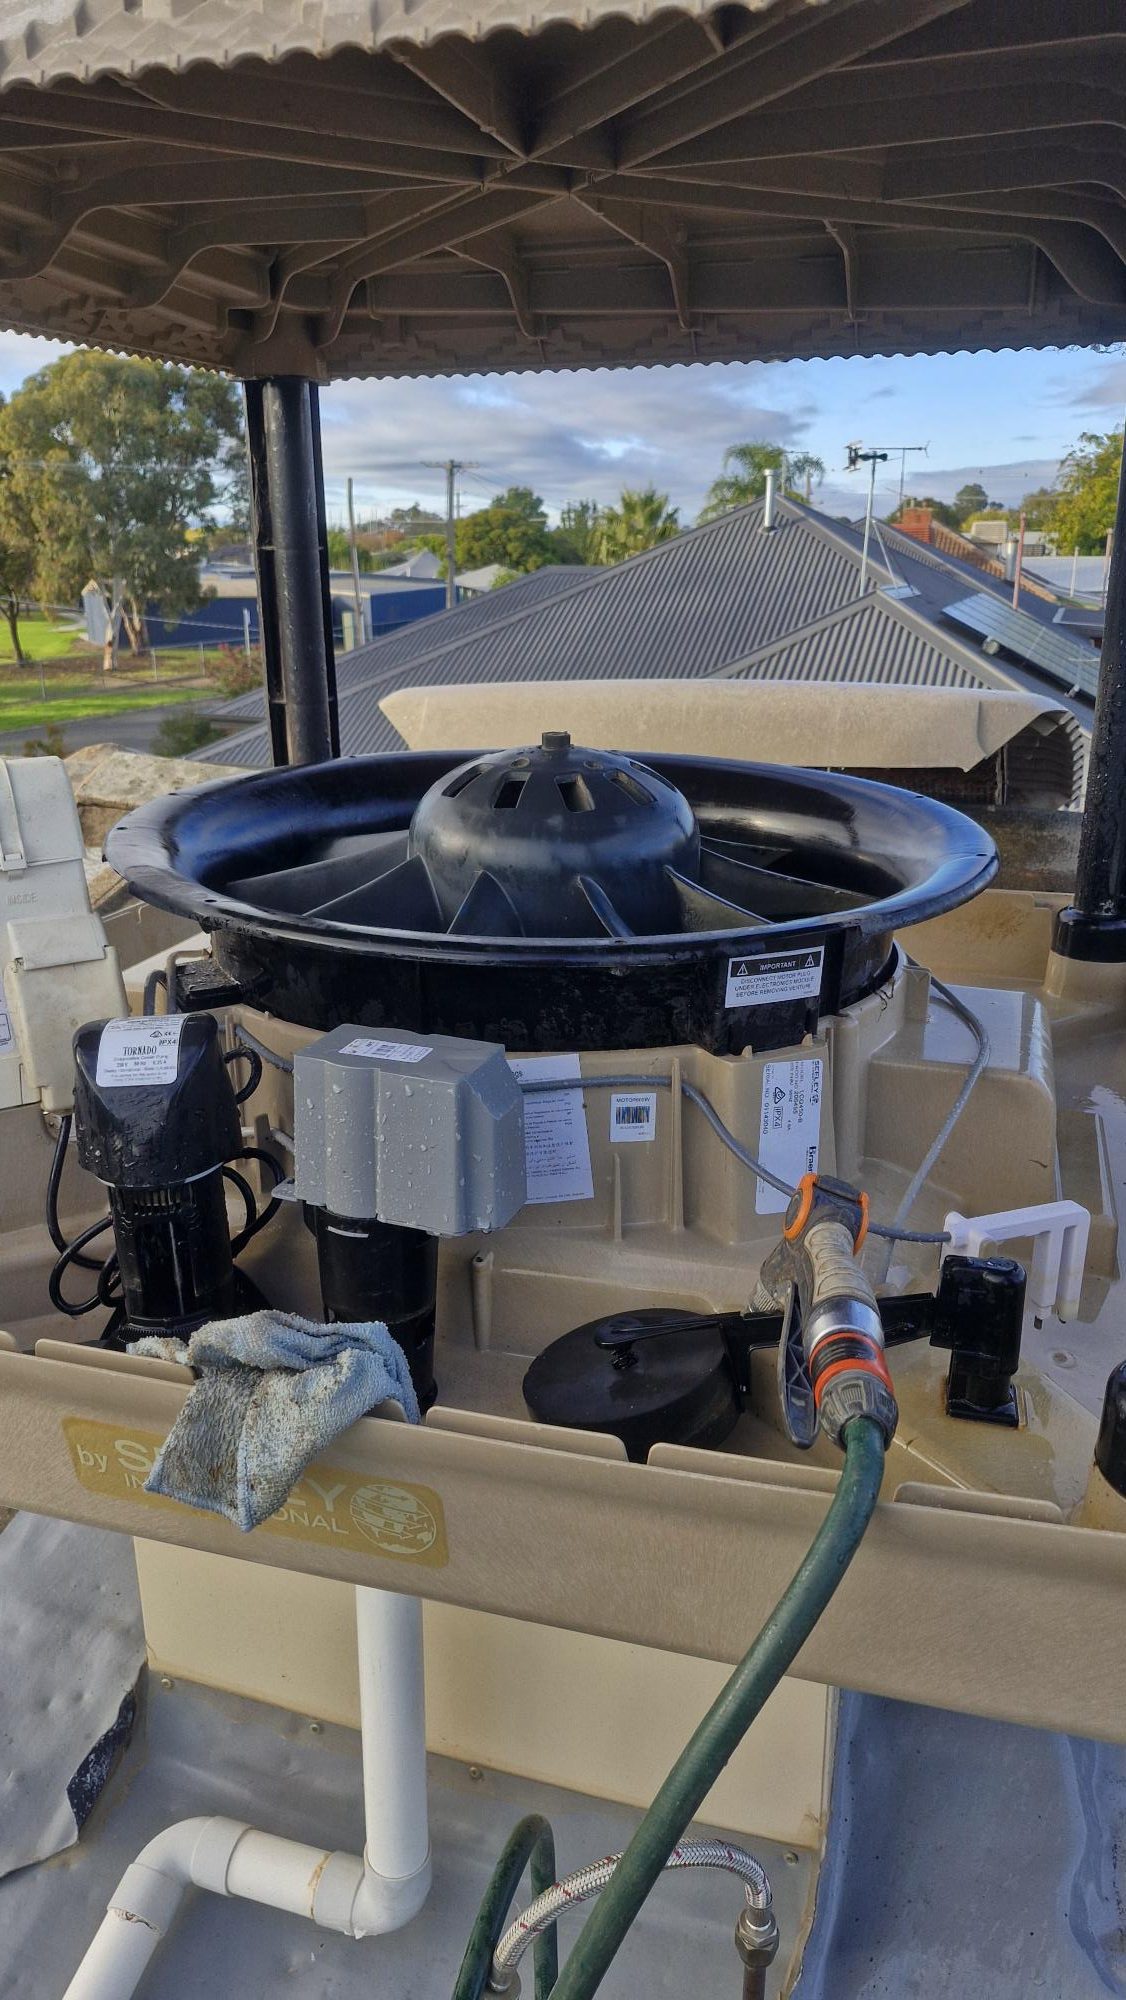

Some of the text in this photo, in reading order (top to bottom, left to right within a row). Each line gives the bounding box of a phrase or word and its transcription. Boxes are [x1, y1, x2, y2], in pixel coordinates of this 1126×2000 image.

[760, 961, 797, 971] IMPORTANT
[735, 976, 815, 992] UNDER ELECTRONICS MODULE
[741, 975, 776, 984] DISCONNECT
[777, 972, 796, 980] MOTOR
[736, 990, 758, 998] BEFORE
[760, 986, 788, 995] REMOVING
[123, 1045, 158, 1056] TORNADO
[774, 1107, 782, 1127] IPX4
[76, 1443, 108, 1473] by
